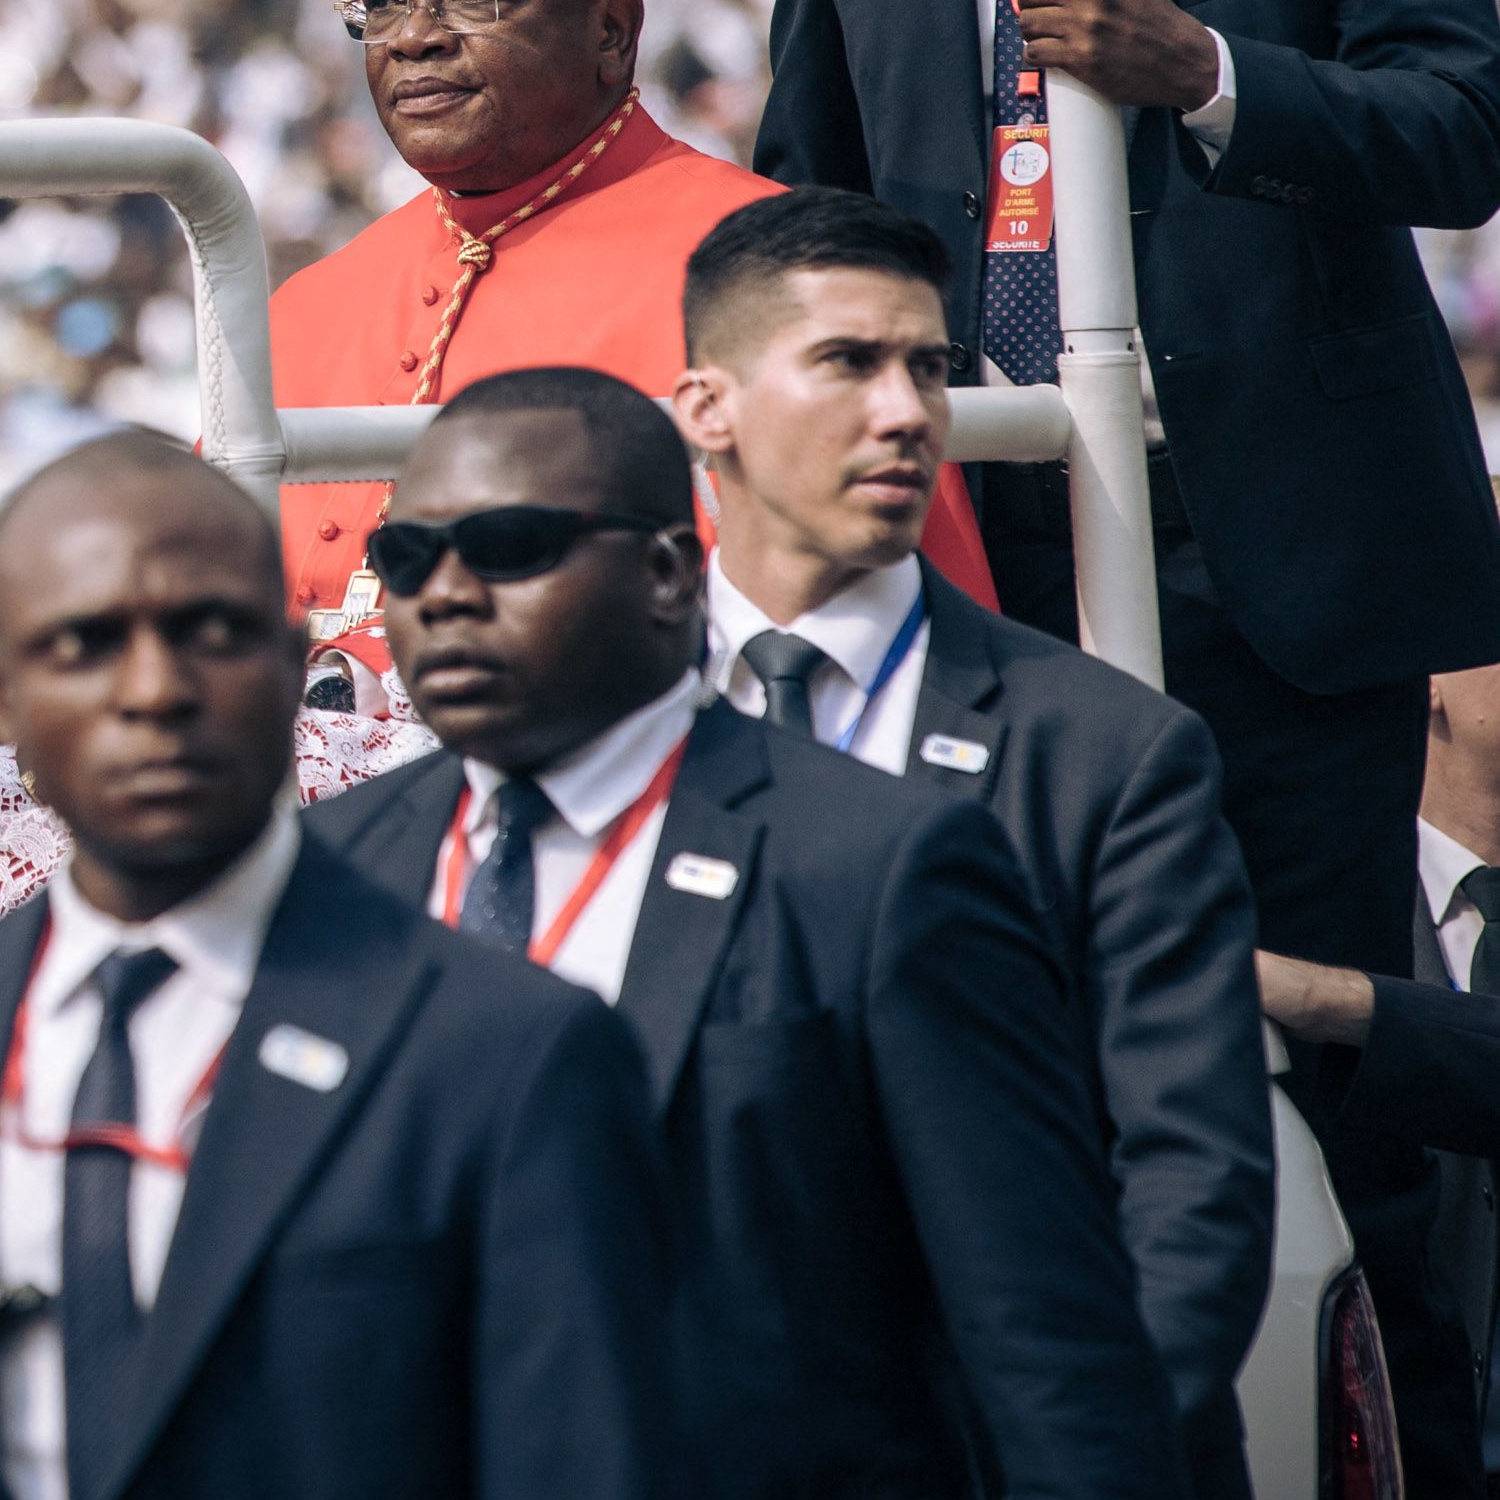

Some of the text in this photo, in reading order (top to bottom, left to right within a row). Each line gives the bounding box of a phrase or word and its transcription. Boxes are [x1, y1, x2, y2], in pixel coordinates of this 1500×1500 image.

[1009, 188, 1032, 196] PORT
[1004, 198, 1035, 206] D'ARME
[1009, 220, 1029, 235] 10
